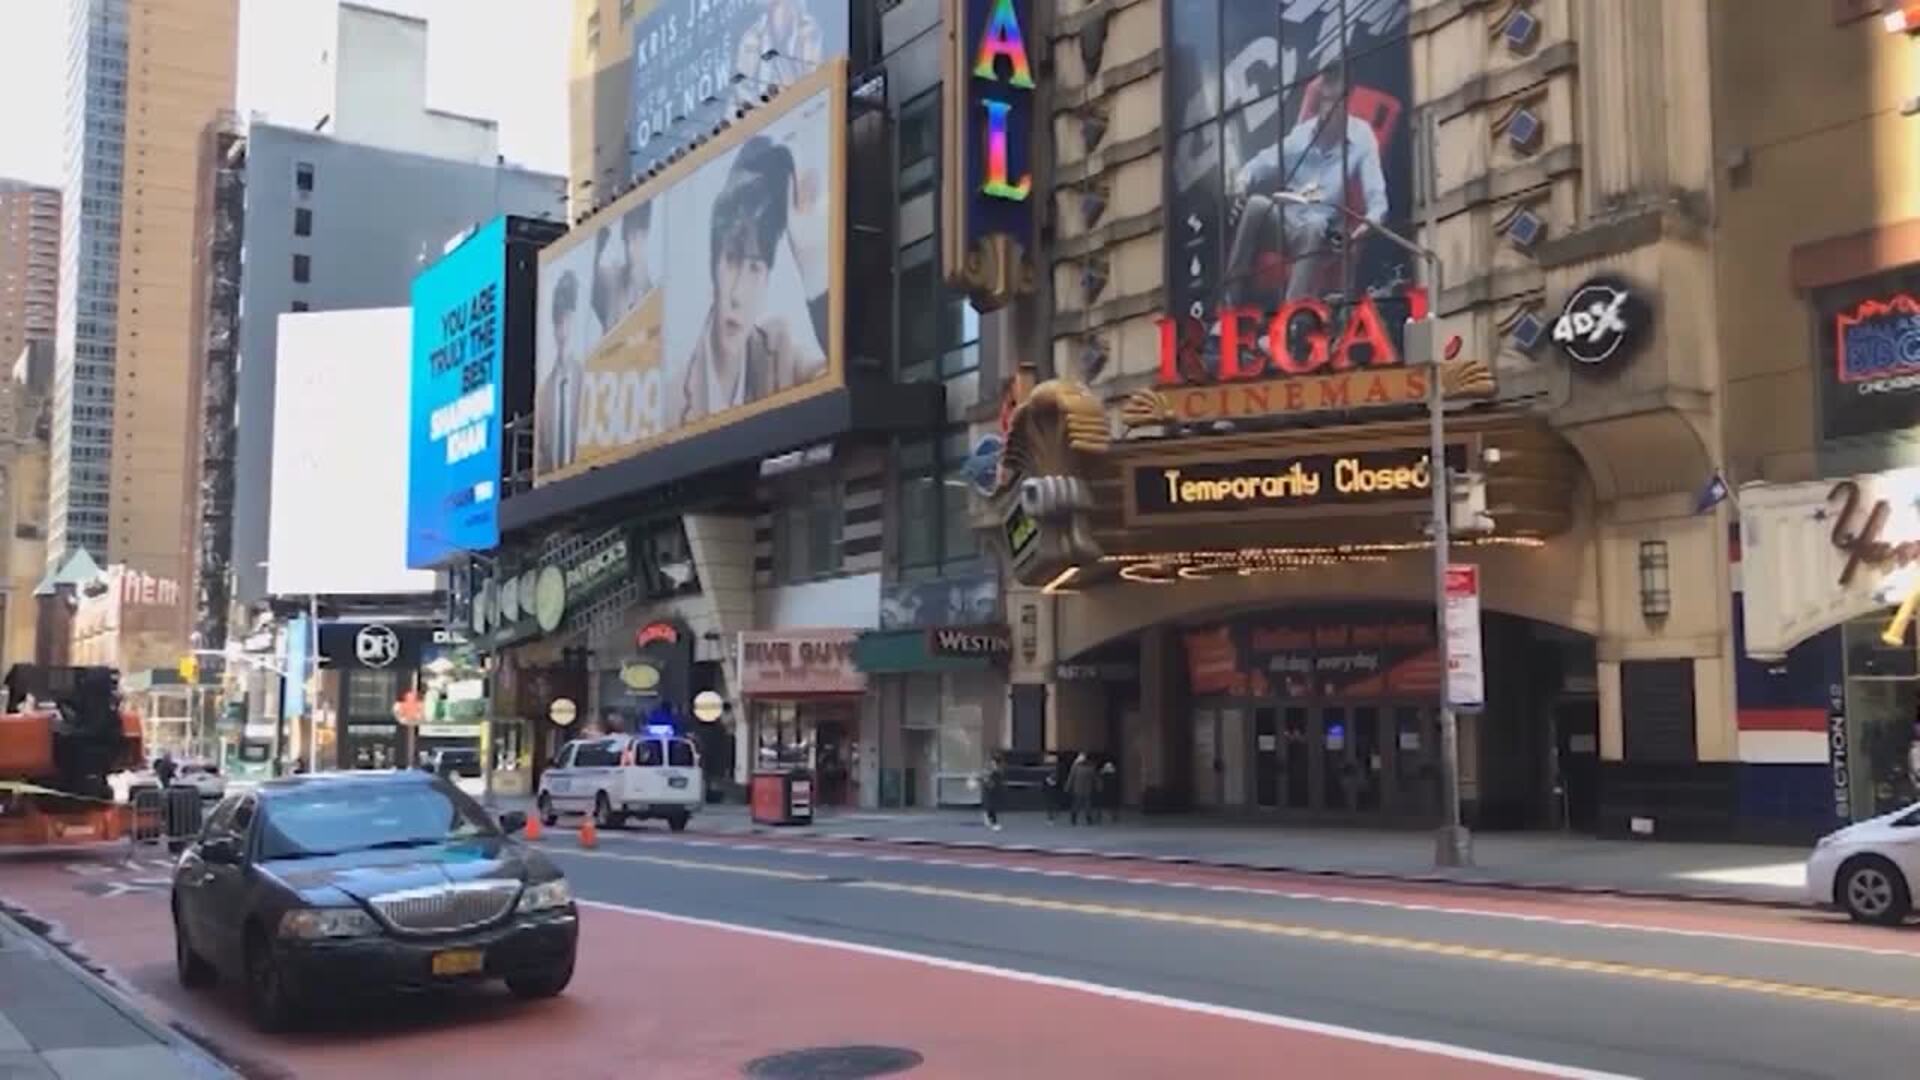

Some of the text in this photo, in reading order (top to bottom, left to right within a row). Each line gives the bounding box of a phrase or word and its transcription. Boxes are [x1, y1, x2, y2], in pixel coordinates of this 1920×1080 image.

[686, 0, 721, 28] JA
[683, 61, 731, 118] NOW
[441, 282, 496, 340] YOU ARE
[429, 315, 495, 378] TRULY THE
[462, 350, 494, 395] BEST
[1183, 374, 1427, 418] CINEMAS
[1164, 455, 1432, 502] Temporarily Closed
[1831, 716, 1849, 817] SECTION
